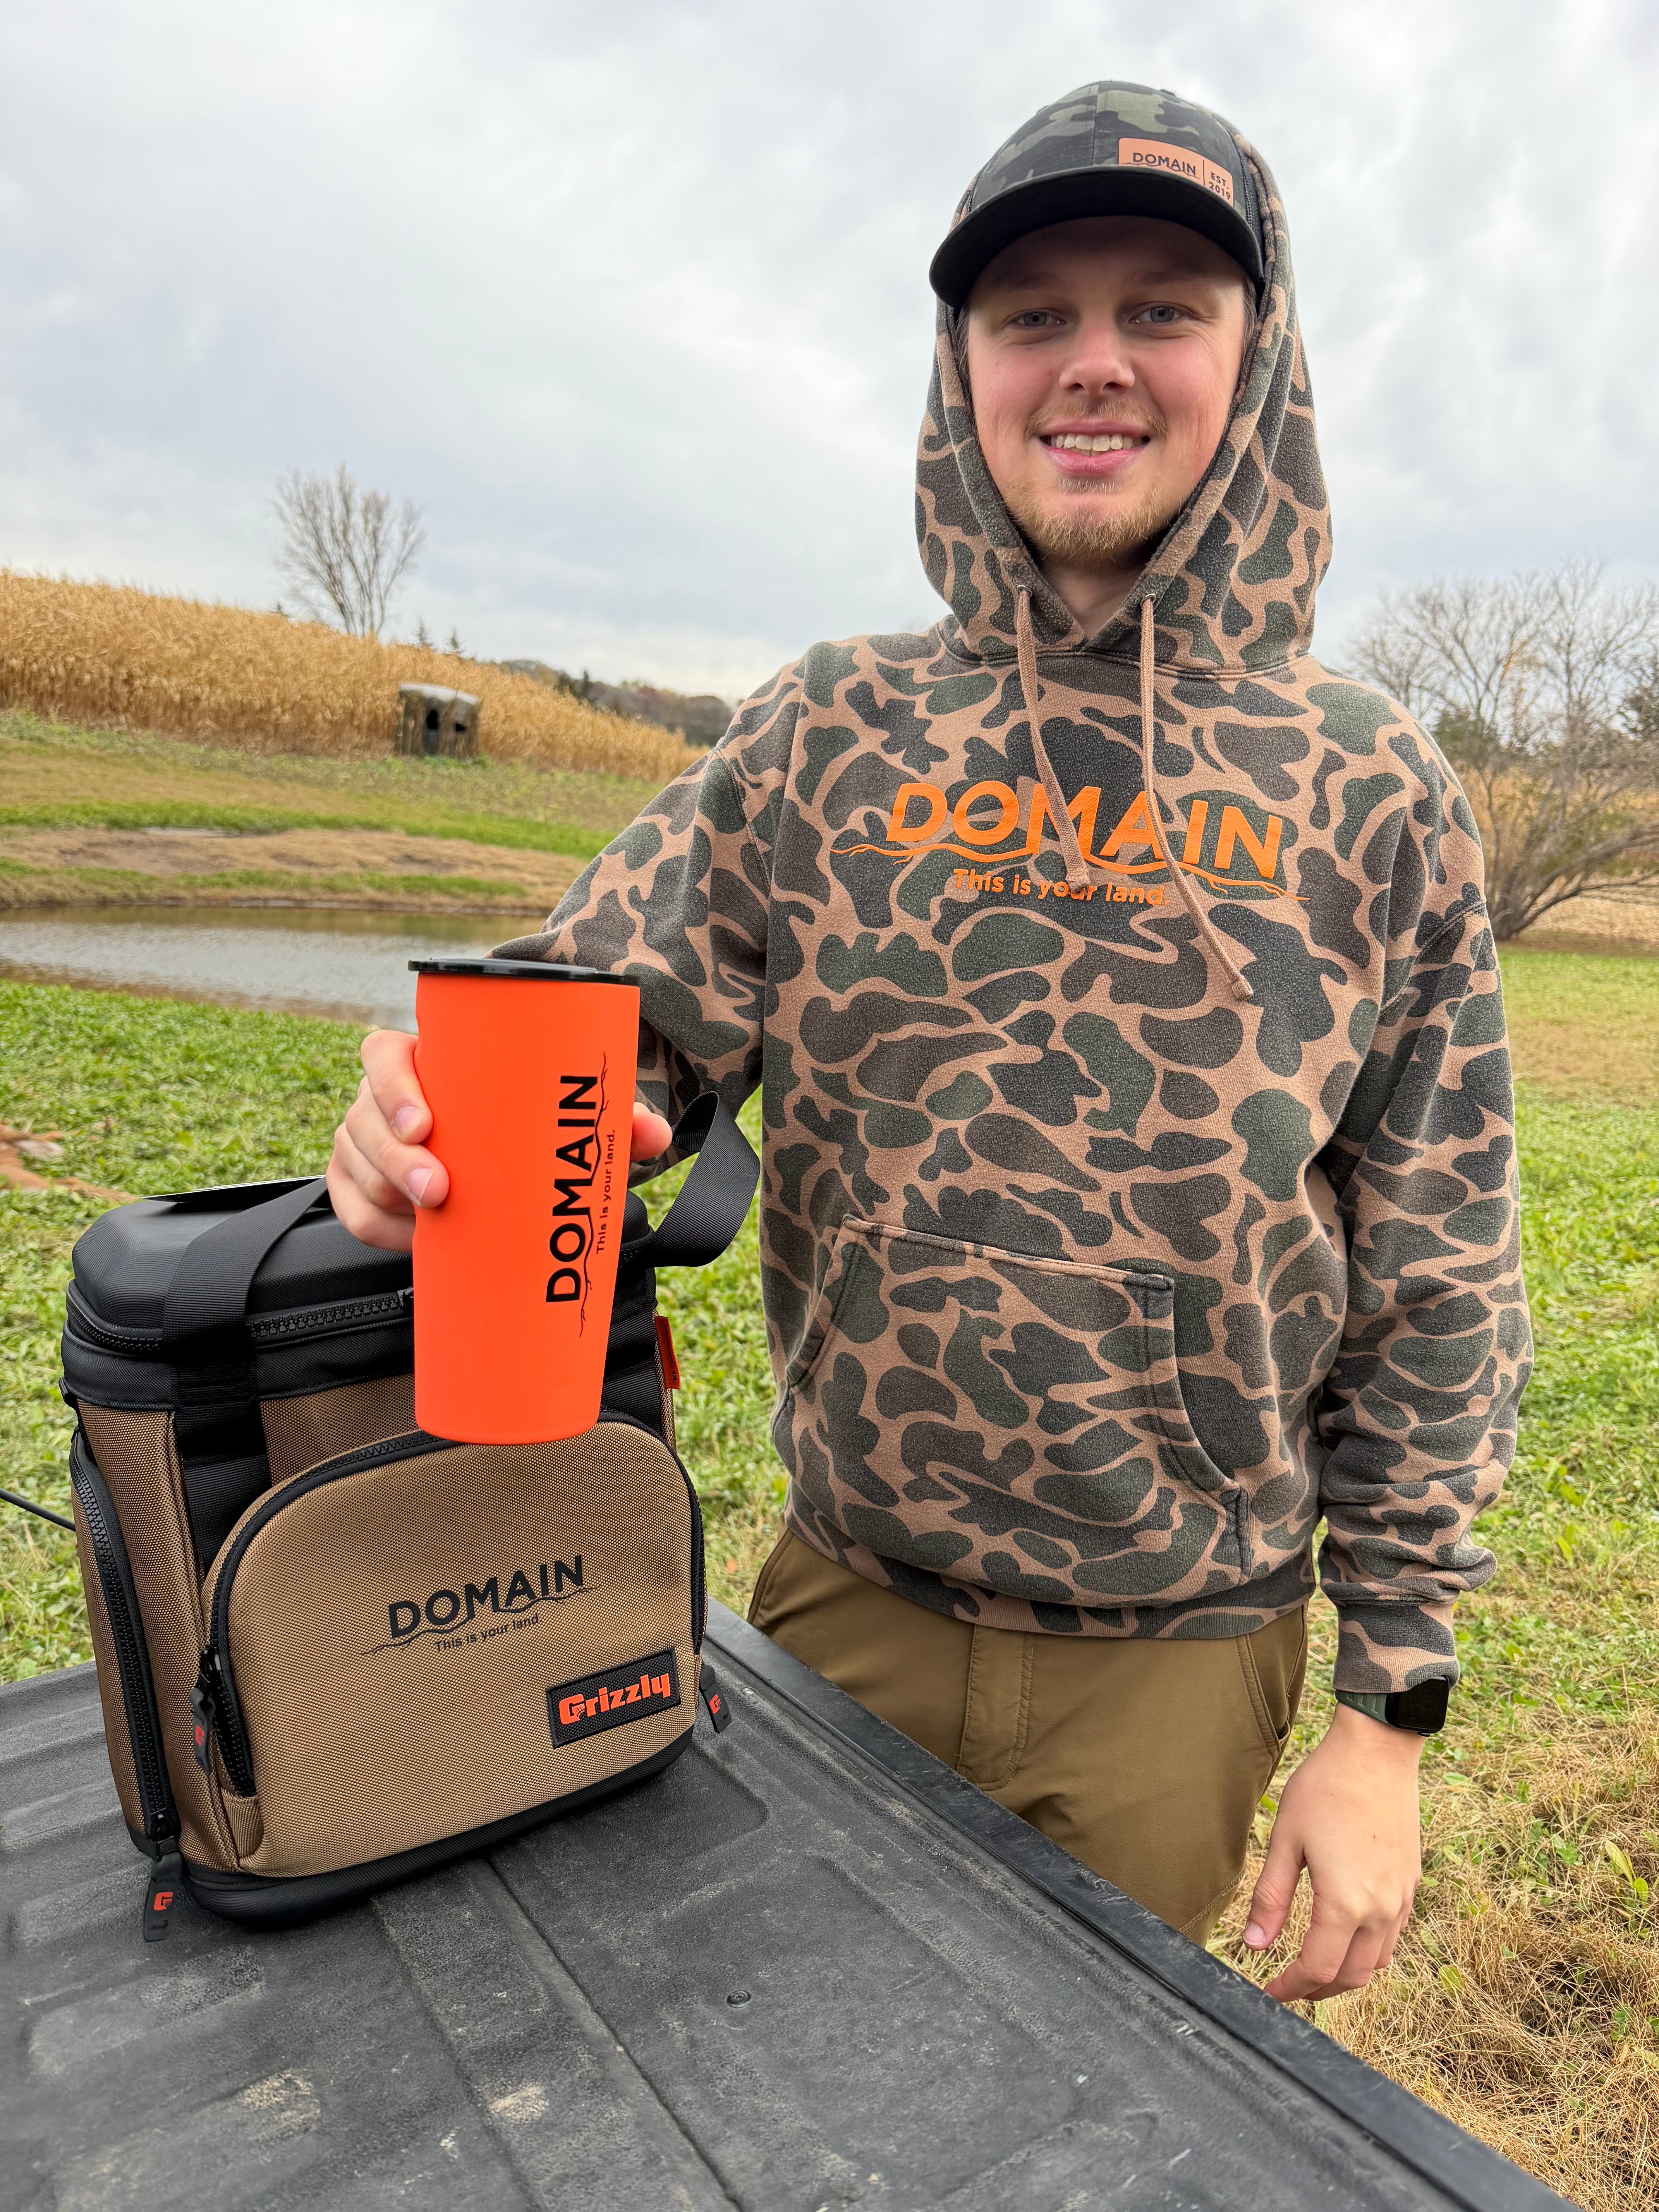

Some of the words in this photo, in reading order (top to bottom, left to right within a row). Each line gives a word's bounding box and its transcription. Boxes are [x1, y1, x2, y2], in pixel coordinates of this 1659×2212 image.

[1132, 152, 1196, 175] DOMAIN
[1209, 182, 1231, 200] 2019
[1211, 172, 1230, 190] EST.
[886, 780, 1283, 879] DOMAIN
[953, 868, 1005, 893] This
[1012, 874, 1032, 895] is
[1105, 882, 1170, 906] land.
[605, 1129, 615, 1164] land.
[546, 1075, 598, 1303] DOMAIN
[603, 1169, 612, 1202] your
[600, 1206, 609, 1219] is
[596, 1223, 607, 1255] This
[388, 1554, 583, 1638] DOMAIN
[434, 1637, 463, 1653] This
[466, 1633, 477, 1644] is
[481, 1623, 509, 1642] your
[558, 1673, 671, 1725] Grizzly
